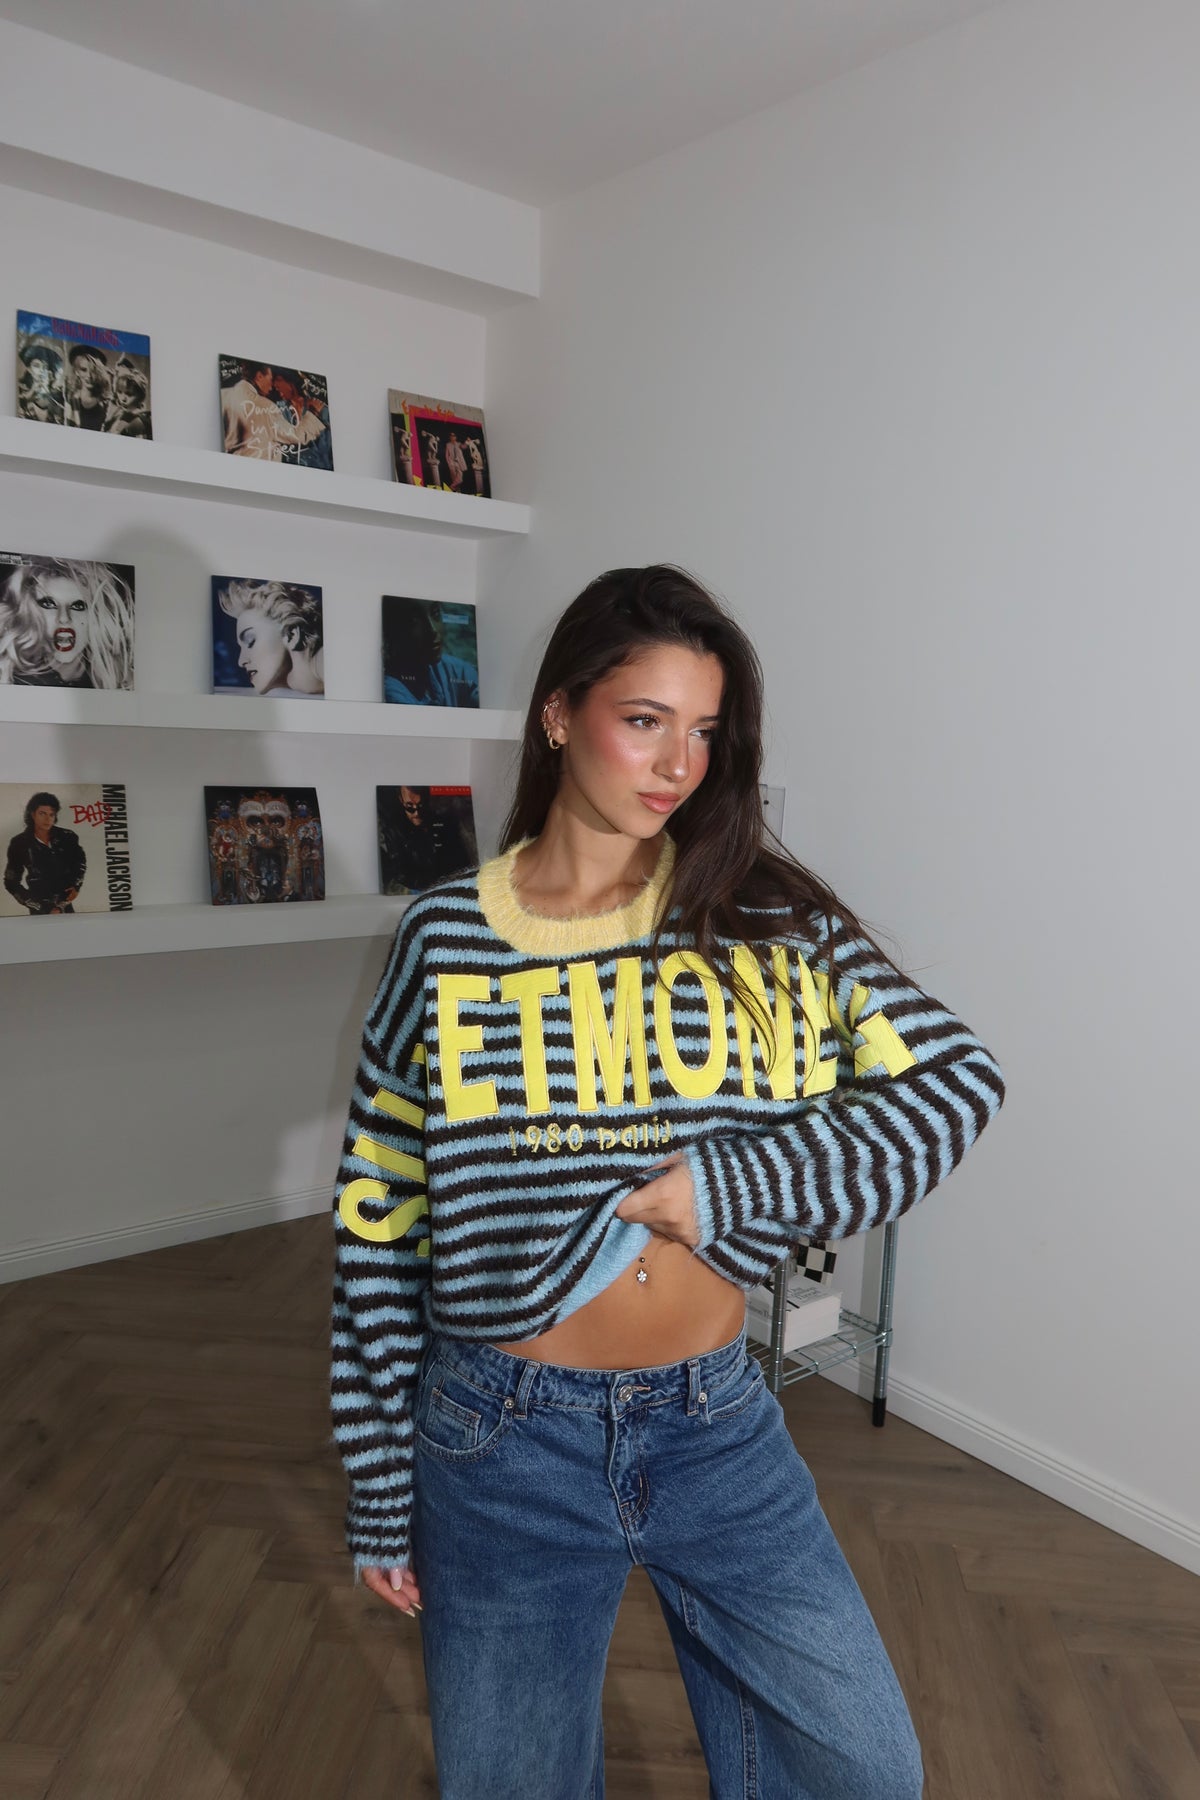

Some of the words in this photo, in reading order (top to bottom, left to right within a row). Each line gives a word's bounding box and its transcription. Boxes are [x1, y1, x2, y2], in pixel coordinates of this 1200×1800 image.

[240, 399, 300, 429] Dancing
[250, 420, 268, 436] in
[69, 801, 112, 827] BAD
[102, 784, 129, 846] MICHAEL
[105, 847, 133, 912] JACKSON
[508, 1122, 584, 1156] 1980
